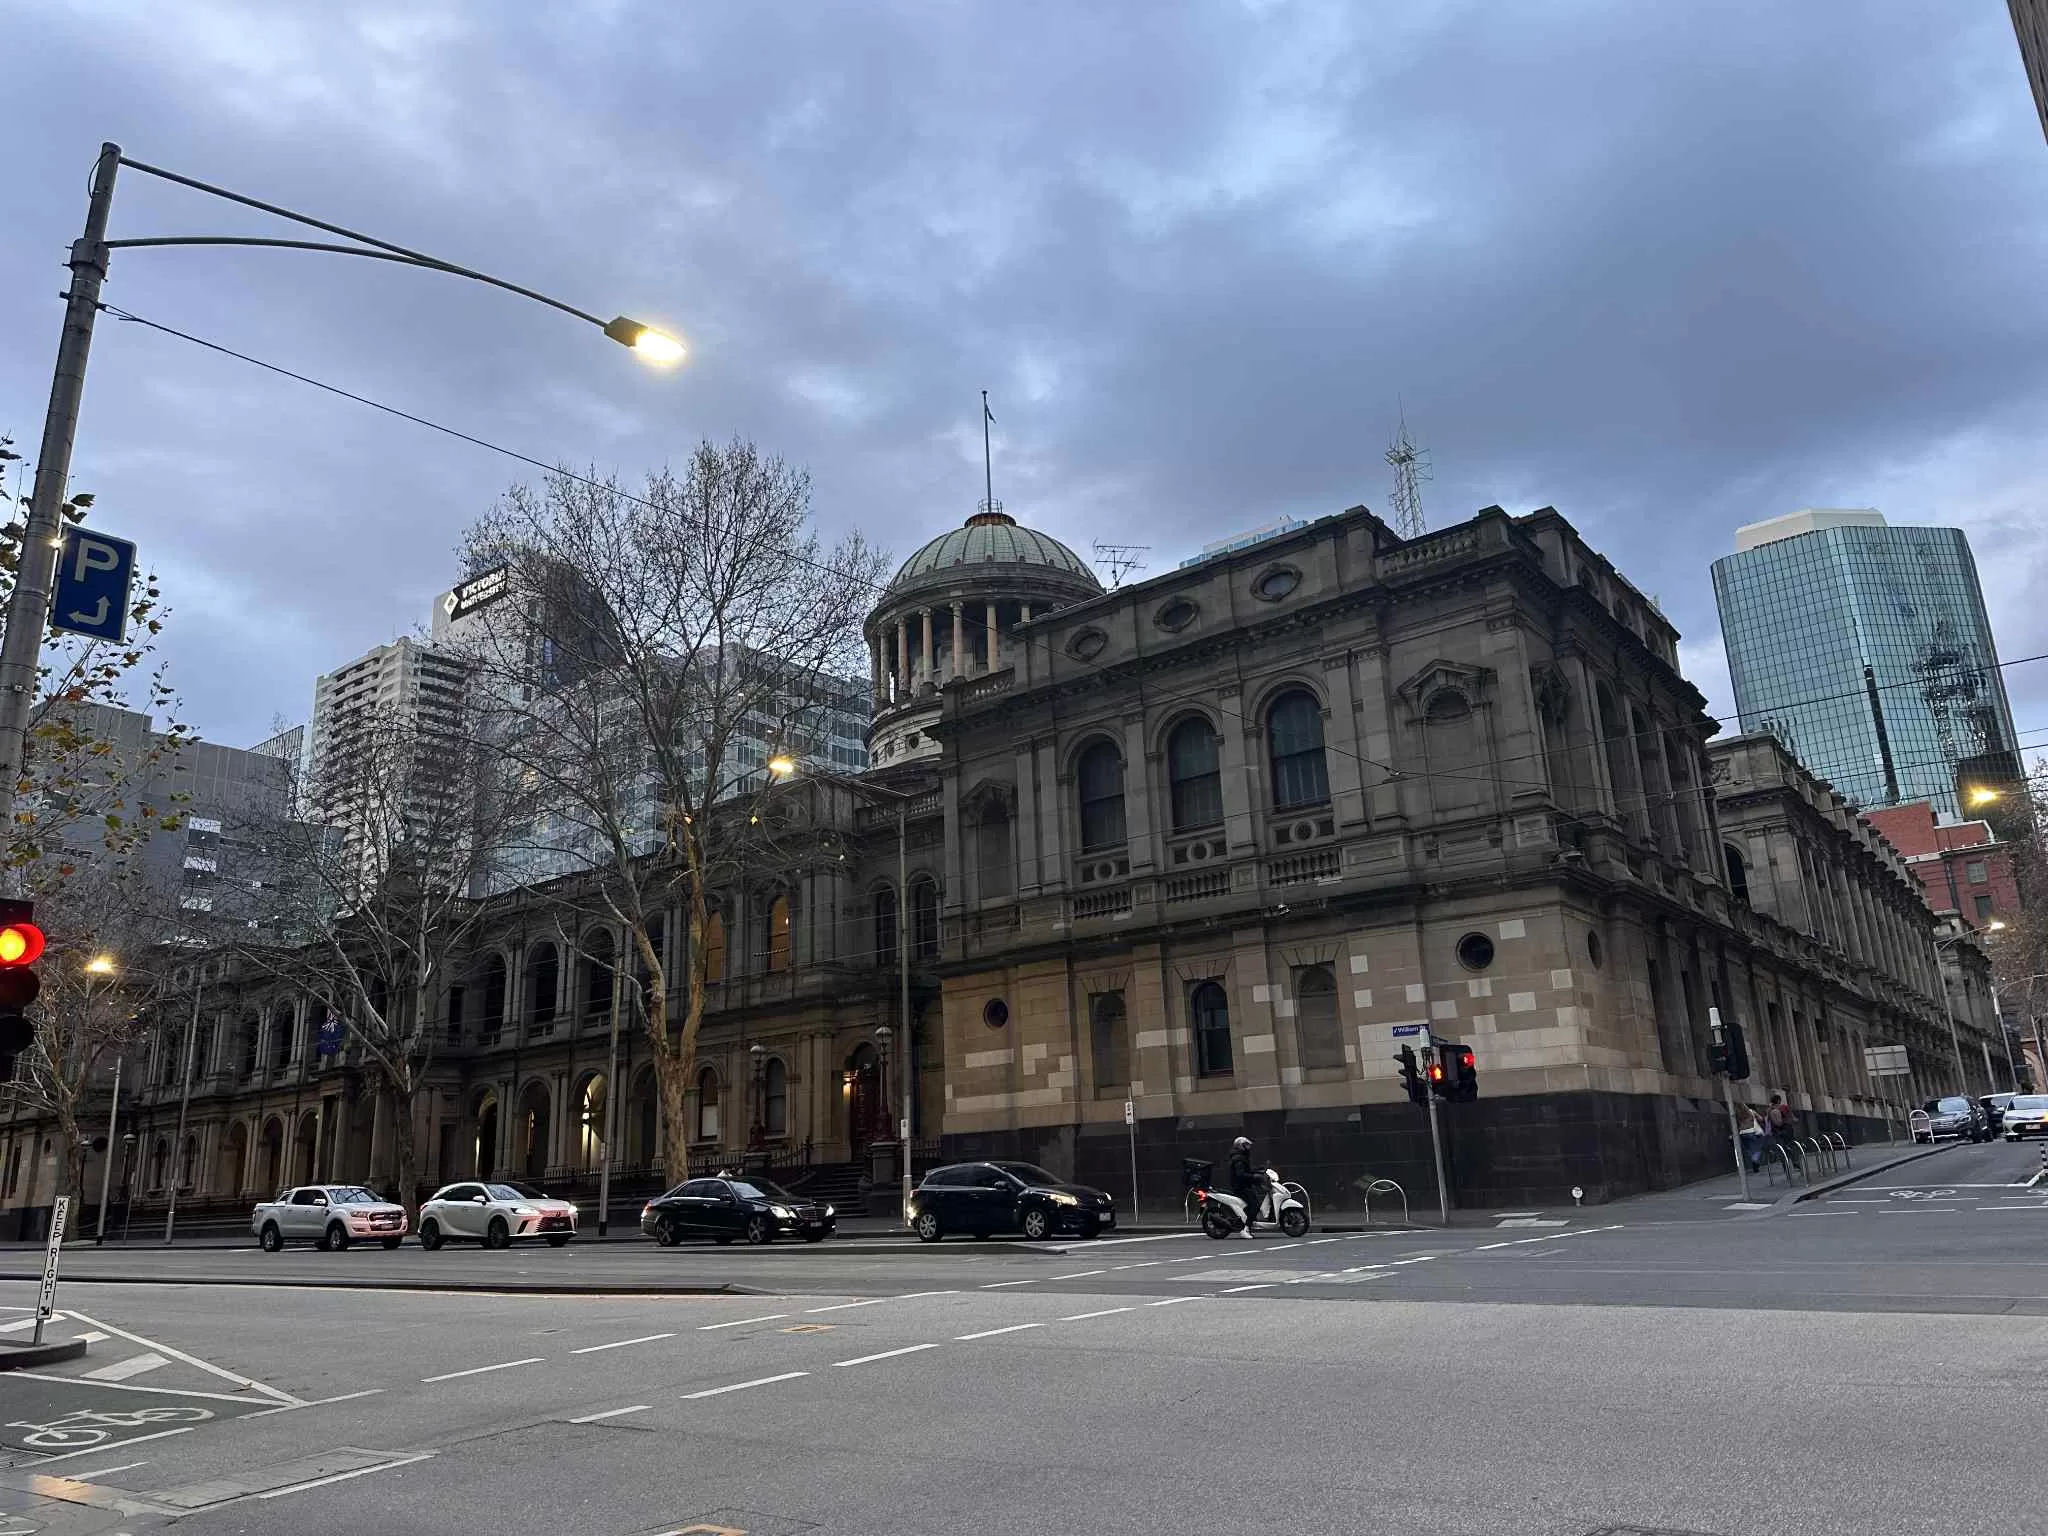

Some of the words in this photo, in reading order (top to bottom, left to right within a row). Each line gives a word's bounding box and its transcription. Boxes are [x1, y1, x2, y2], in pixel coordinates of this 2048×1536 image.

[74, 538, 119, 582] P
[462, 568, 506, 598] VICTORIA
[53, 1200, 66, 1241] KEEP
[44, 1247, 58, 1300] RIGHT
